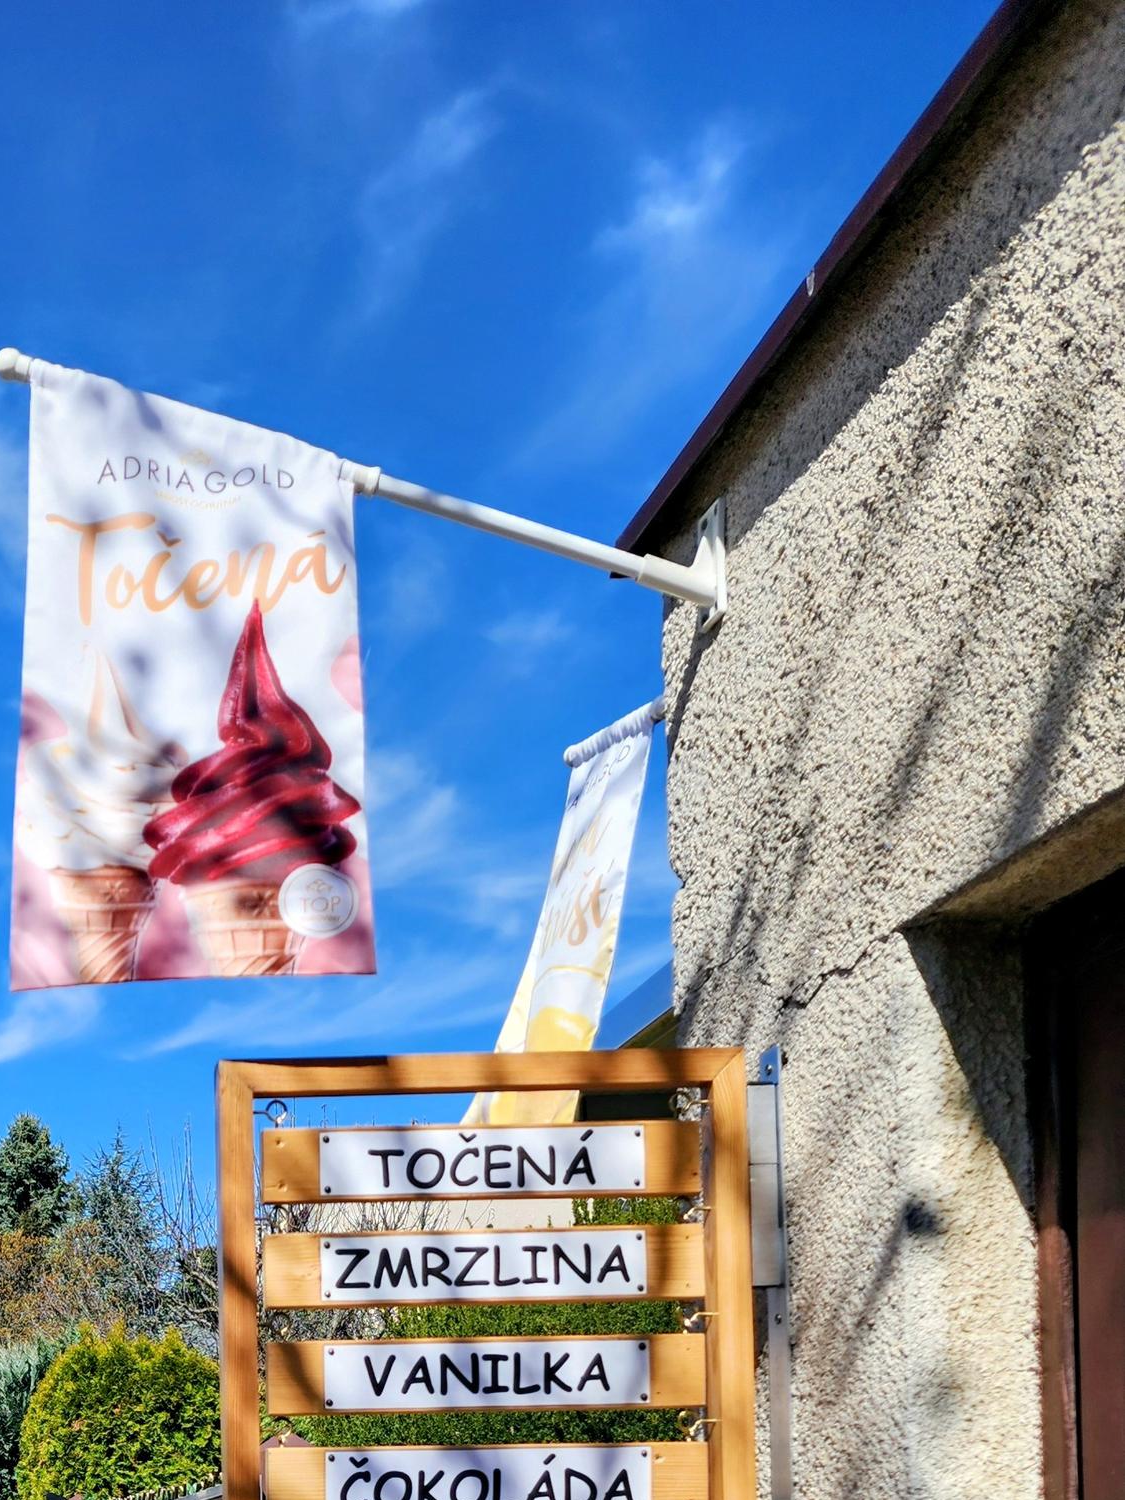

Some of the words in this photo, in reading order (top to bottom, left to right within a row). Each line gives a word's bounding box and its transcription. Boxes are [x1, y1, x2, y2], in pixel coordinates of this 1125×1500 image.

[45, 511, 347, 629] Točená
[299, 895, 342, 913] TOP
[368, 1130, 596, 1190] TOČENÁ
[334, 1243, 631, 1289] ZMRZLINA
[363, 1351, 611, 1397] VANILKA
